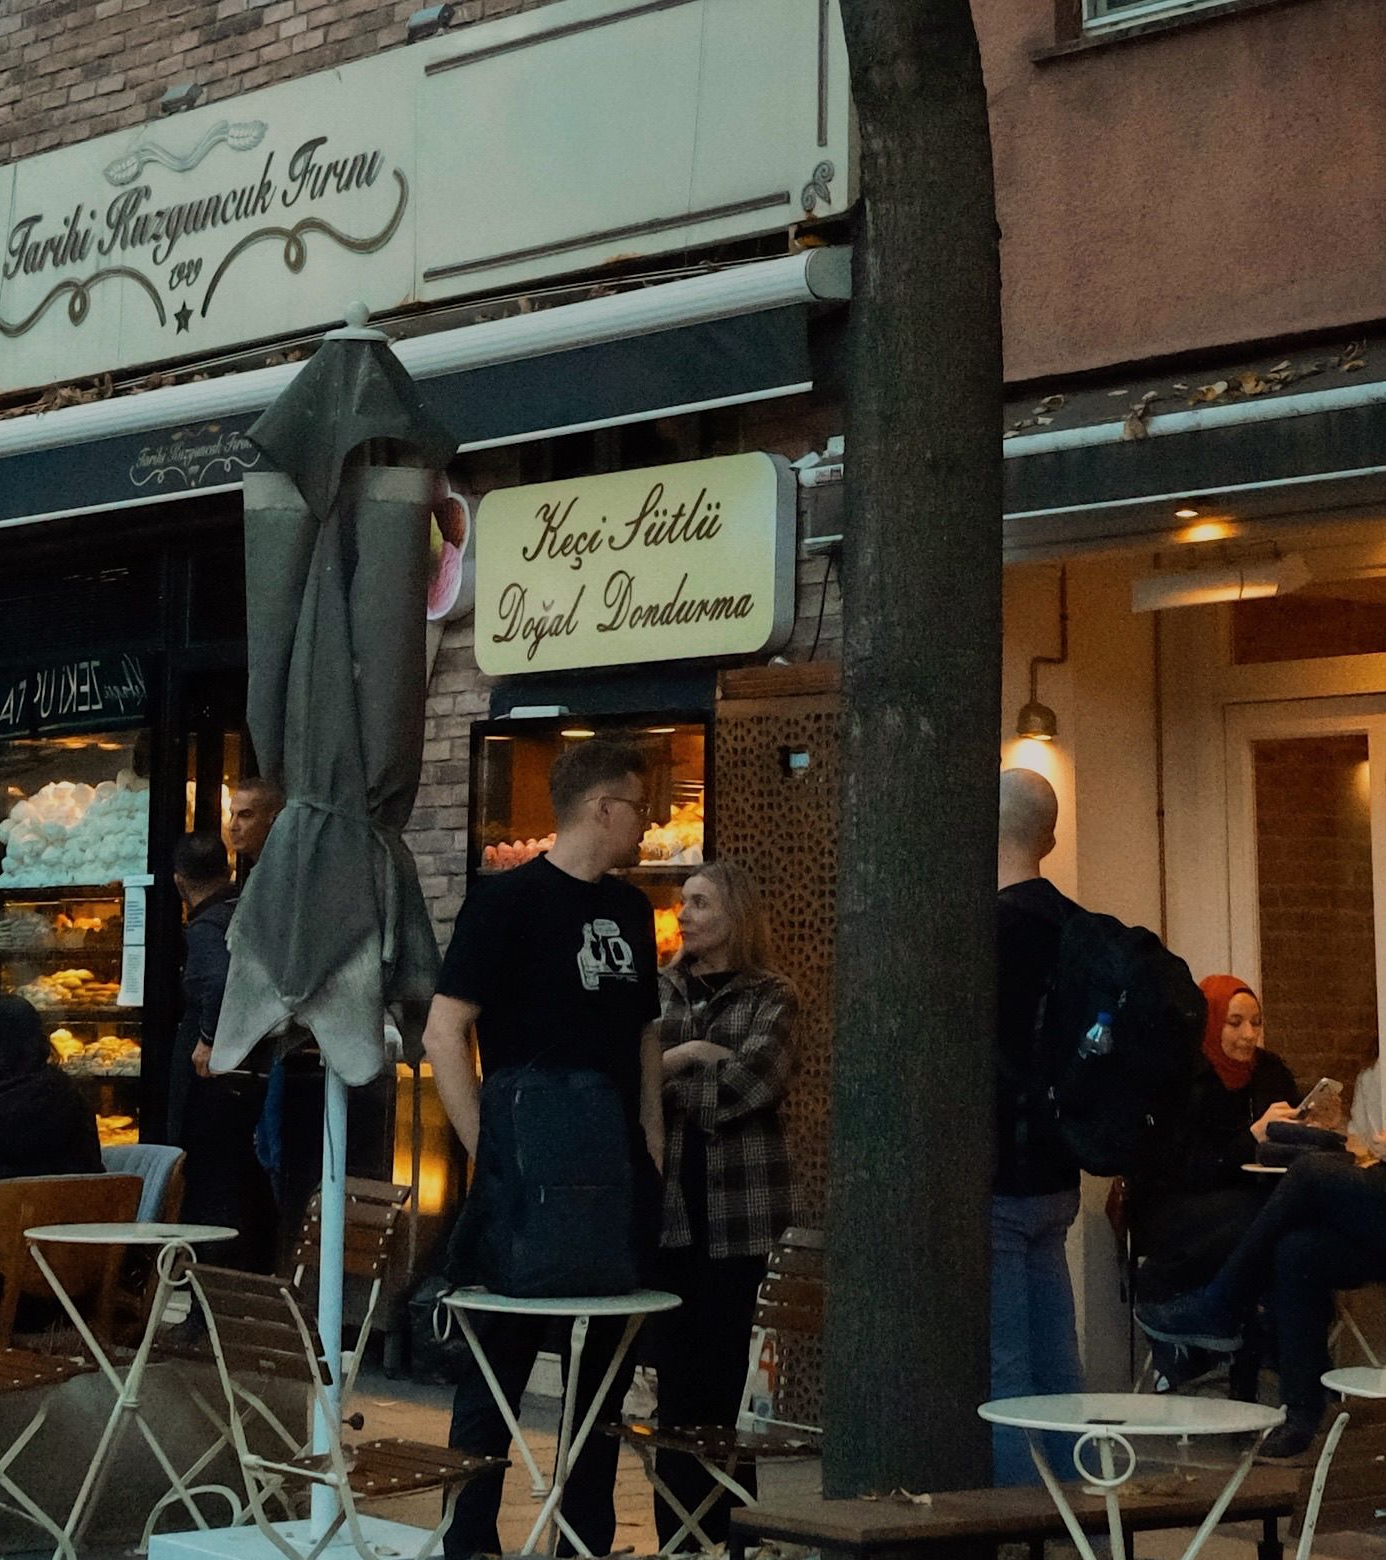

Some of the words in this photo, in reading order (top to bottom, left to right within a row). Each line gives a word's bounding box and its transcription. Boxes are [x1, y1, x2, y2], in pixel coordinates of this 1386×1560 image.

[3, 202, 97, 280] Tarihi
[97, 150, 277, 266] Kuzguncuk
[282, 136, 384, 208] Fırını
[522, 496, 606, 570] Keçi
[608, 482, 722, 551] Sütlü
[492, 582, 585, 661] Doğal
[597, 570, 754, 632] Dondurma
